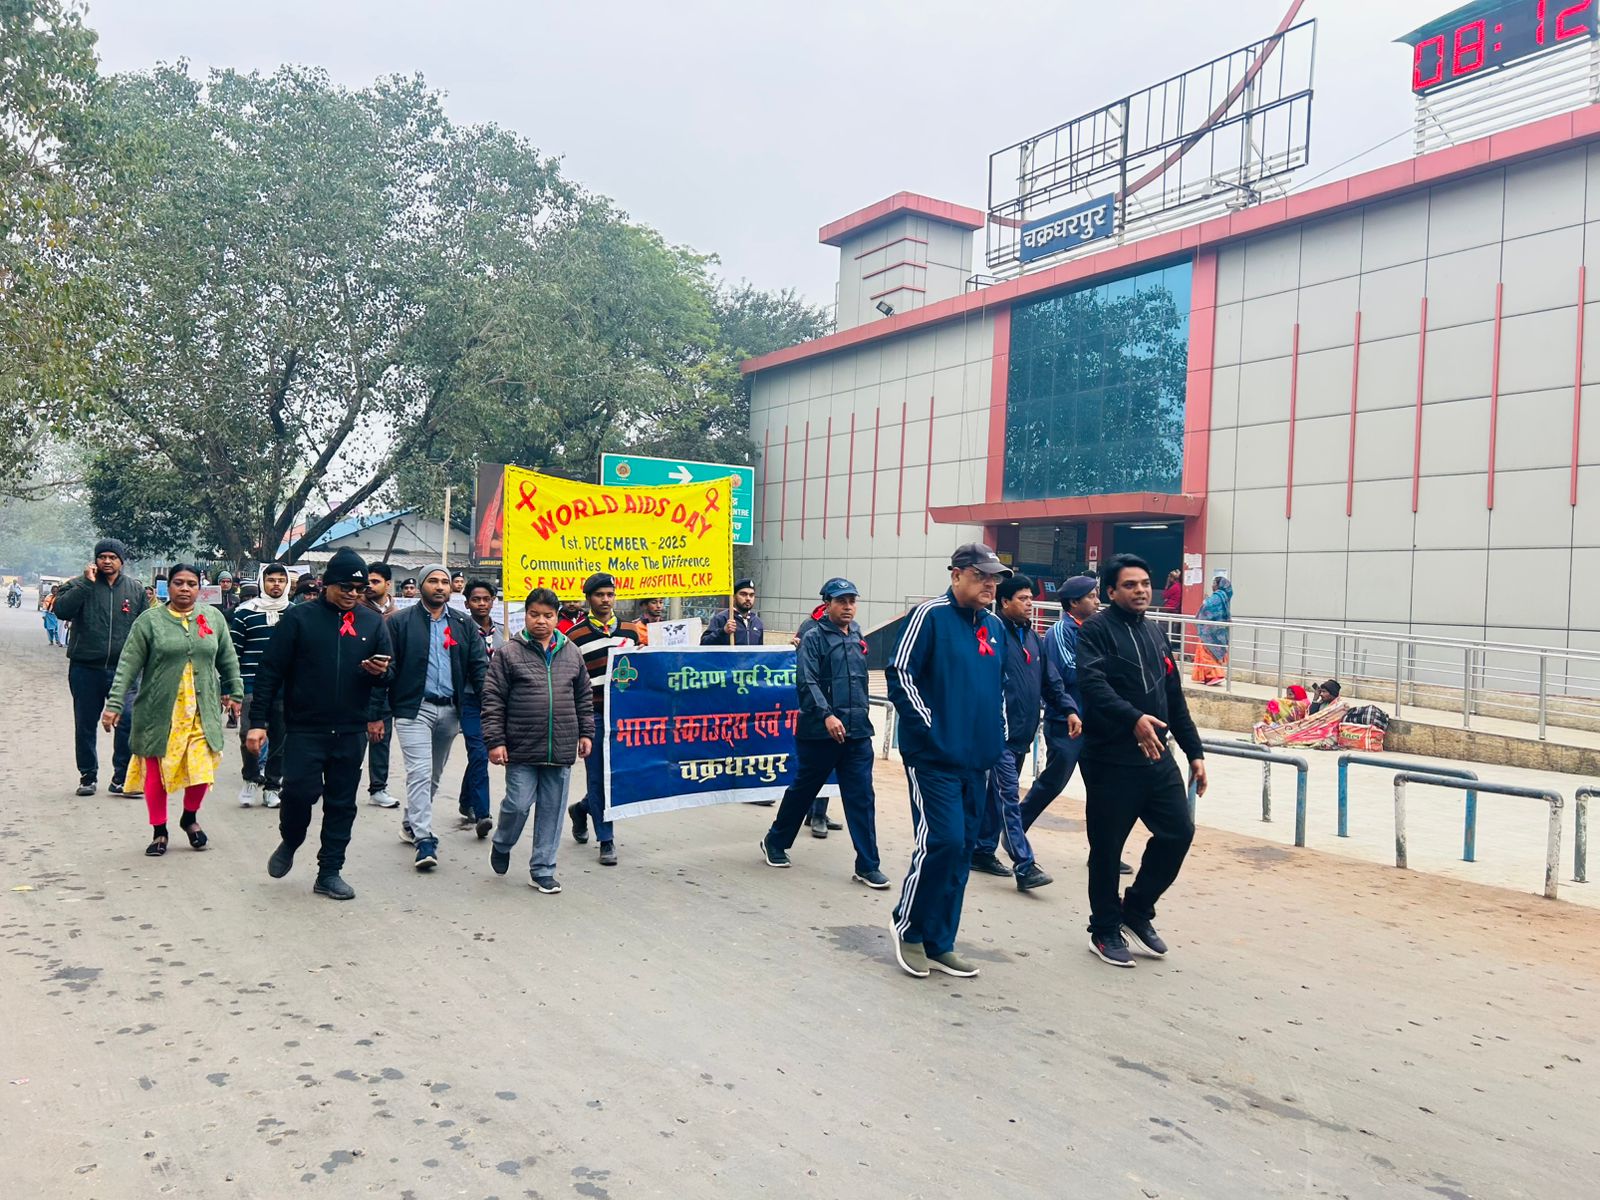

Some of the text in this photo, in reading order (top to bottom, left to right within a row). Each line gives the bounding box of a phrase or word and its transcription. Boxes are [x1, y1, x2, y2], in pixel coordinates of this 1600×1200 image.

[1022, 203, 1107, 248] चक्रधरपुर
[530, 494, 713, 541] WORLD AIDS DAY
[584, 536, 649, 551] DECEMBER
[658, 535, 687, 550] 2025
[520, 554, 710, 572] Communities Make The Difference
[667, 666, 726, 692] दक्षिण
[731, 665, 763, 694] पूर्व
[616, 716, 668, 747] भारत
[673, 712, 751, 748] स्काउट्स
[755, 703, 781, 738] एवं
[678, 753, 790, 784] चक्रधरपुर
